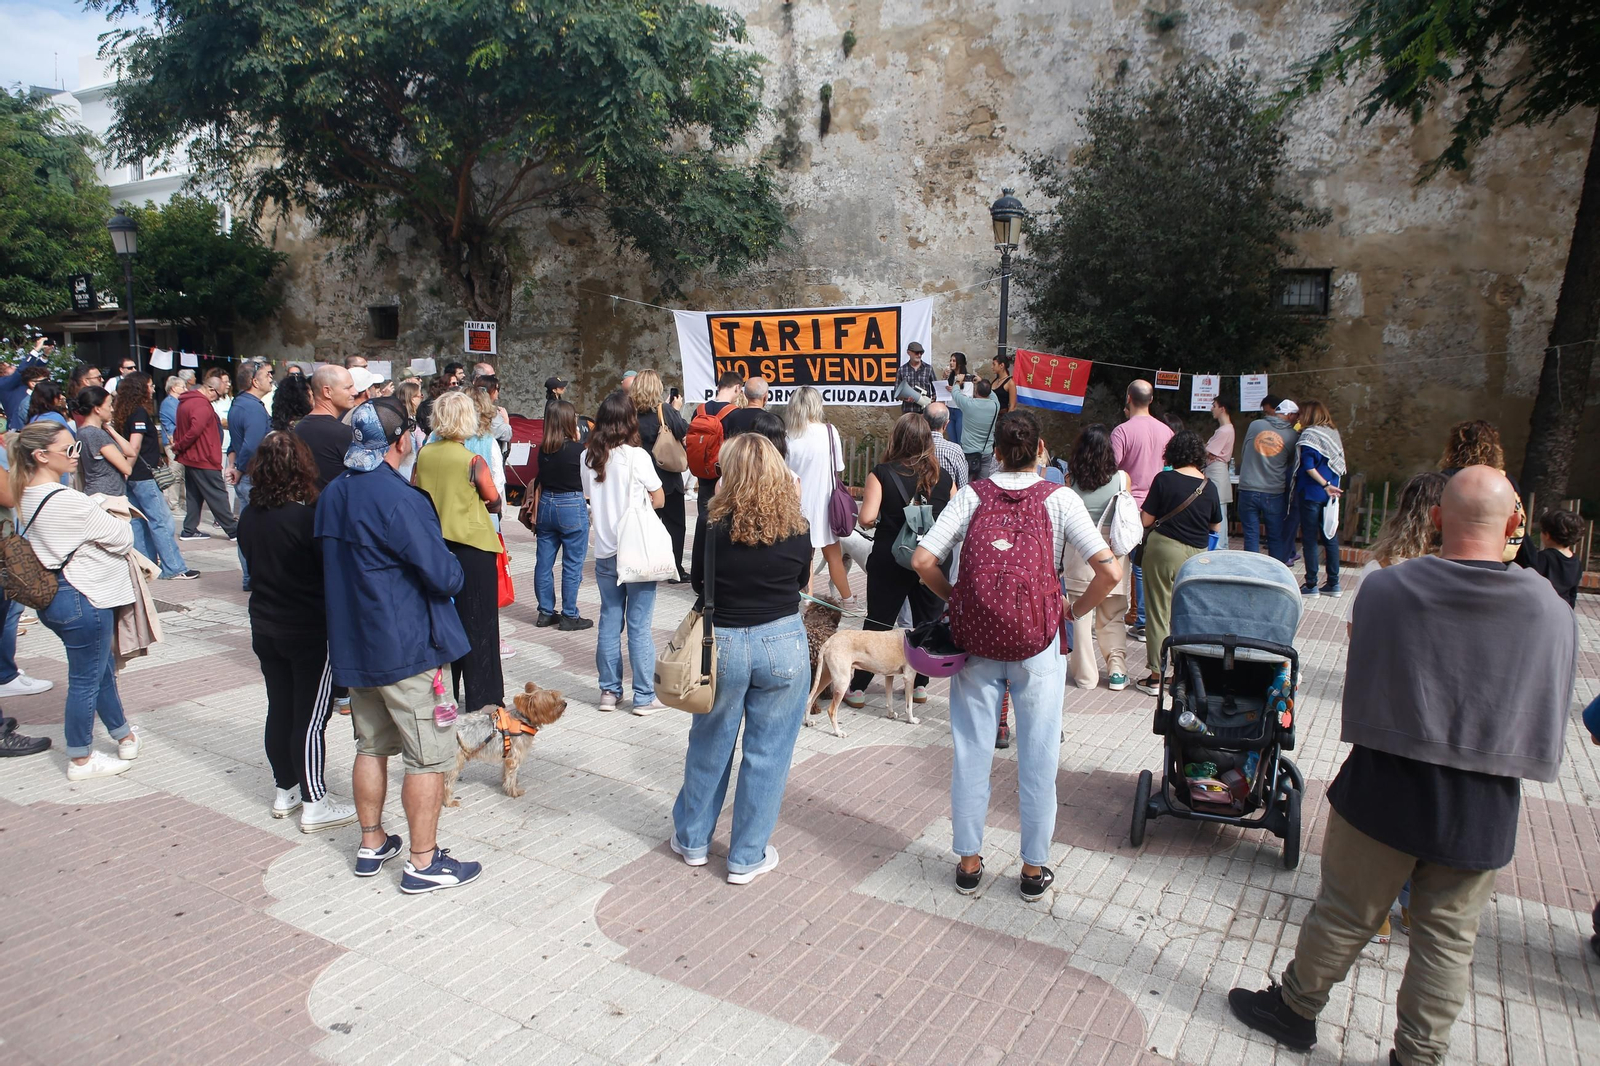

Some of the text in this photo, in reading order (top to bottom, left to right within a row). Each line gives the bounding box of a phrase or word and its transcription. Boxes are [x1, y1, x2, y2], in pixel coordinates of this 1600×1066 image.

[464, 322, 485, 330] TARIFA
[720, 317, 885, 352] TARIFA
[716, 357, 897, 383] NO SE VENDE
